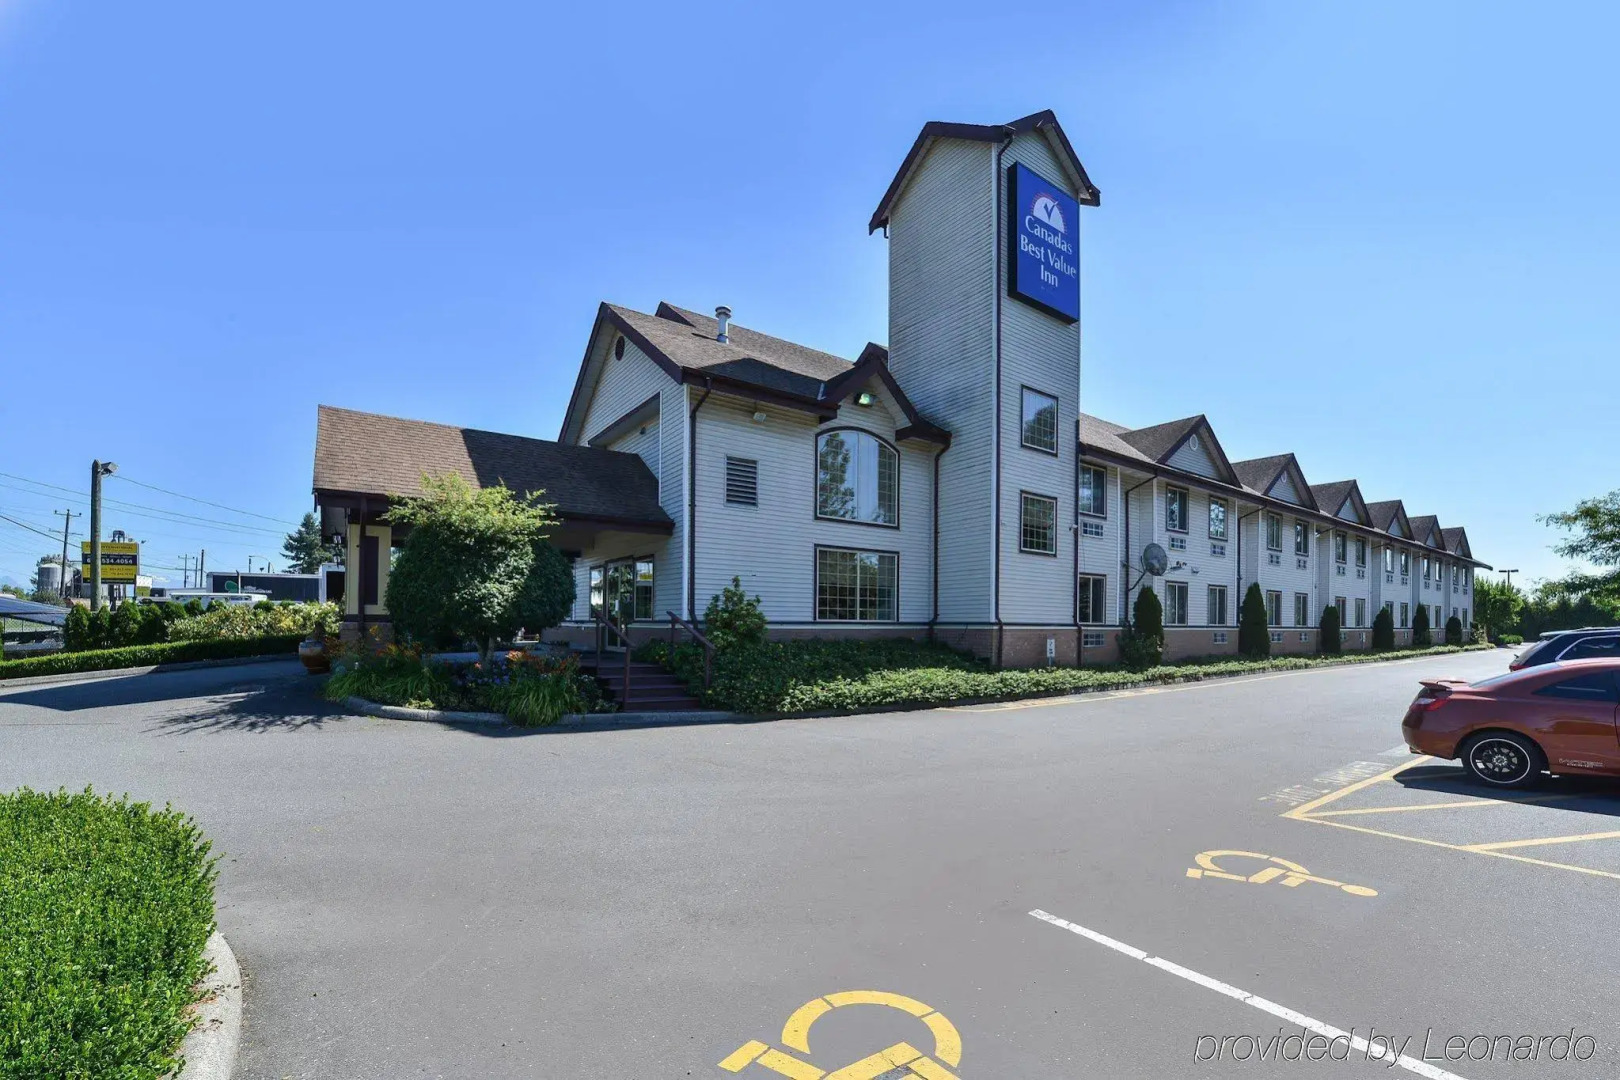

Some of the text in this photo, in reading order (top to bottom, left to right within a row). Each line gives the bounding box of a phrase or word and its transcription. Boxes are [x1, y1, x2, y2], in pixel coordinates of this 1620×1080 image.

[1025, 215, 1073, 255] Canadas
[1020, 234, 1077, 279] Best Value
[1040, 264, 1058, 288] Inn
